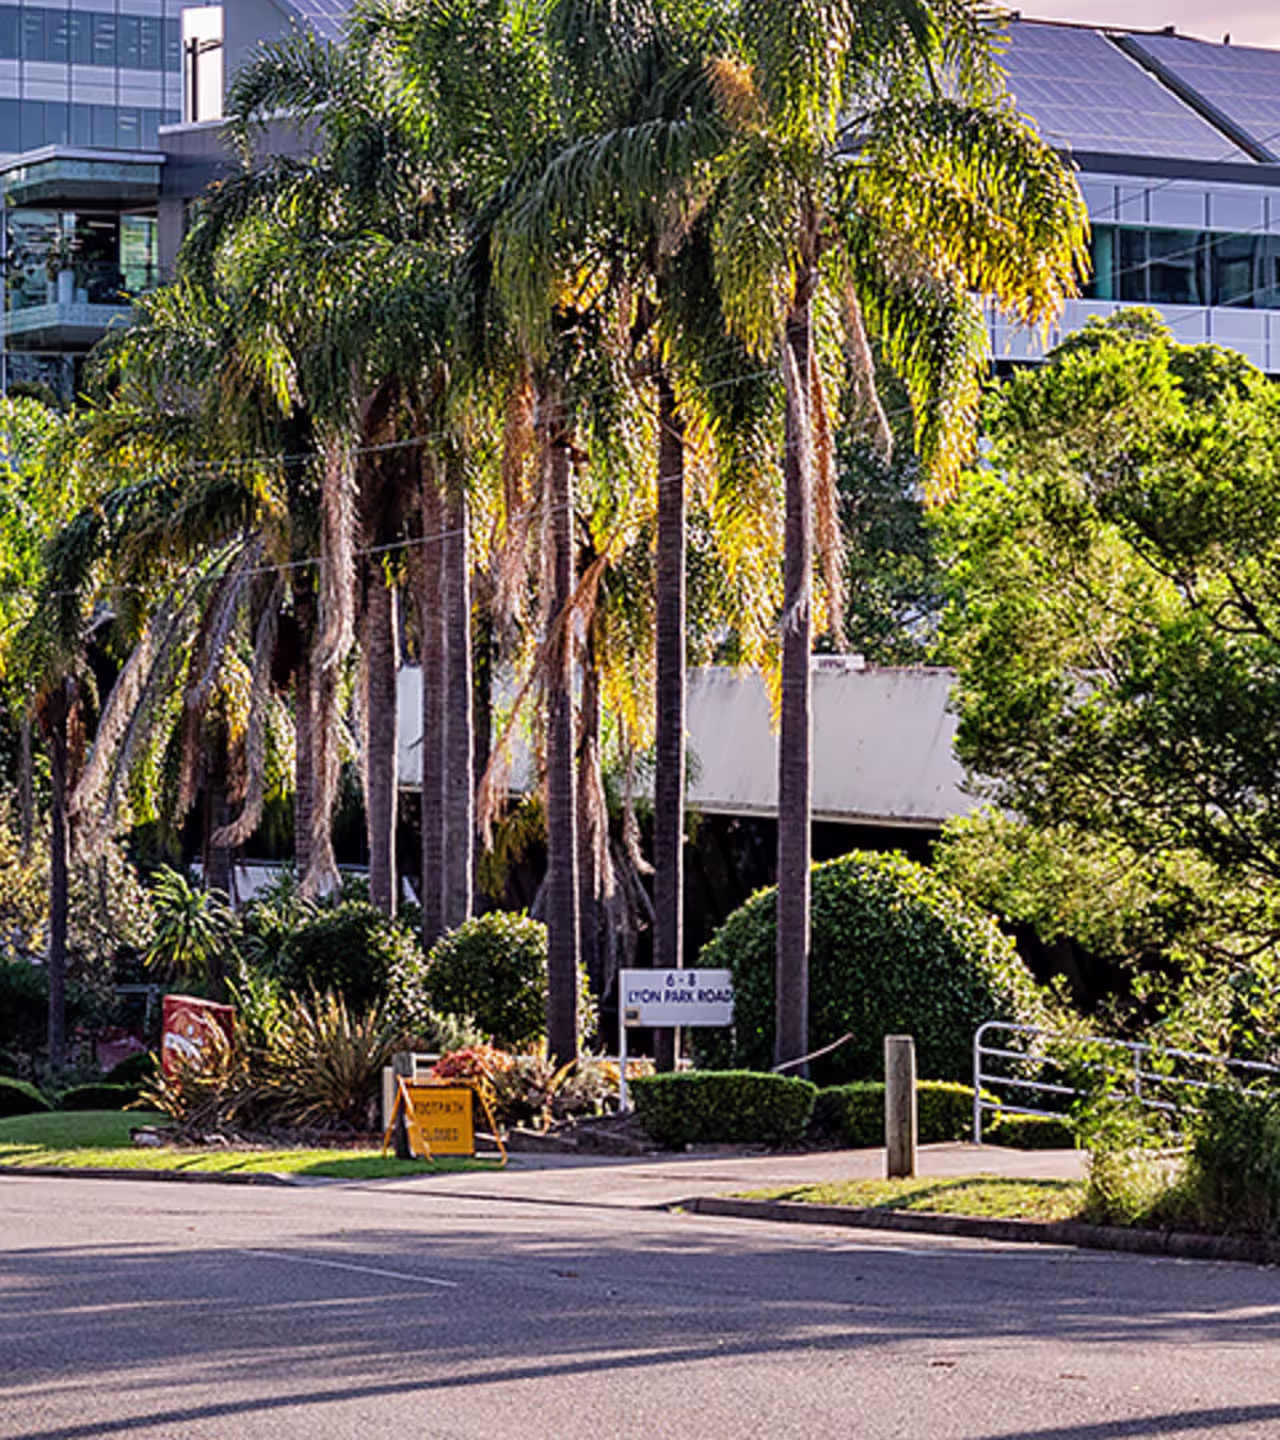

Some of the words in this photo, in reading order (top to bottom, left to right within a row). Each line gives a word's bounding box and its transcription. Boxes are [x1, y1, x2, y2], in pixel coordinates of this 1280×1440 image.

[628, 989, 662, 1003] LYON
[664, 989, 695, 1003] PARK
[697, 989, 734, 1003] ROAD
